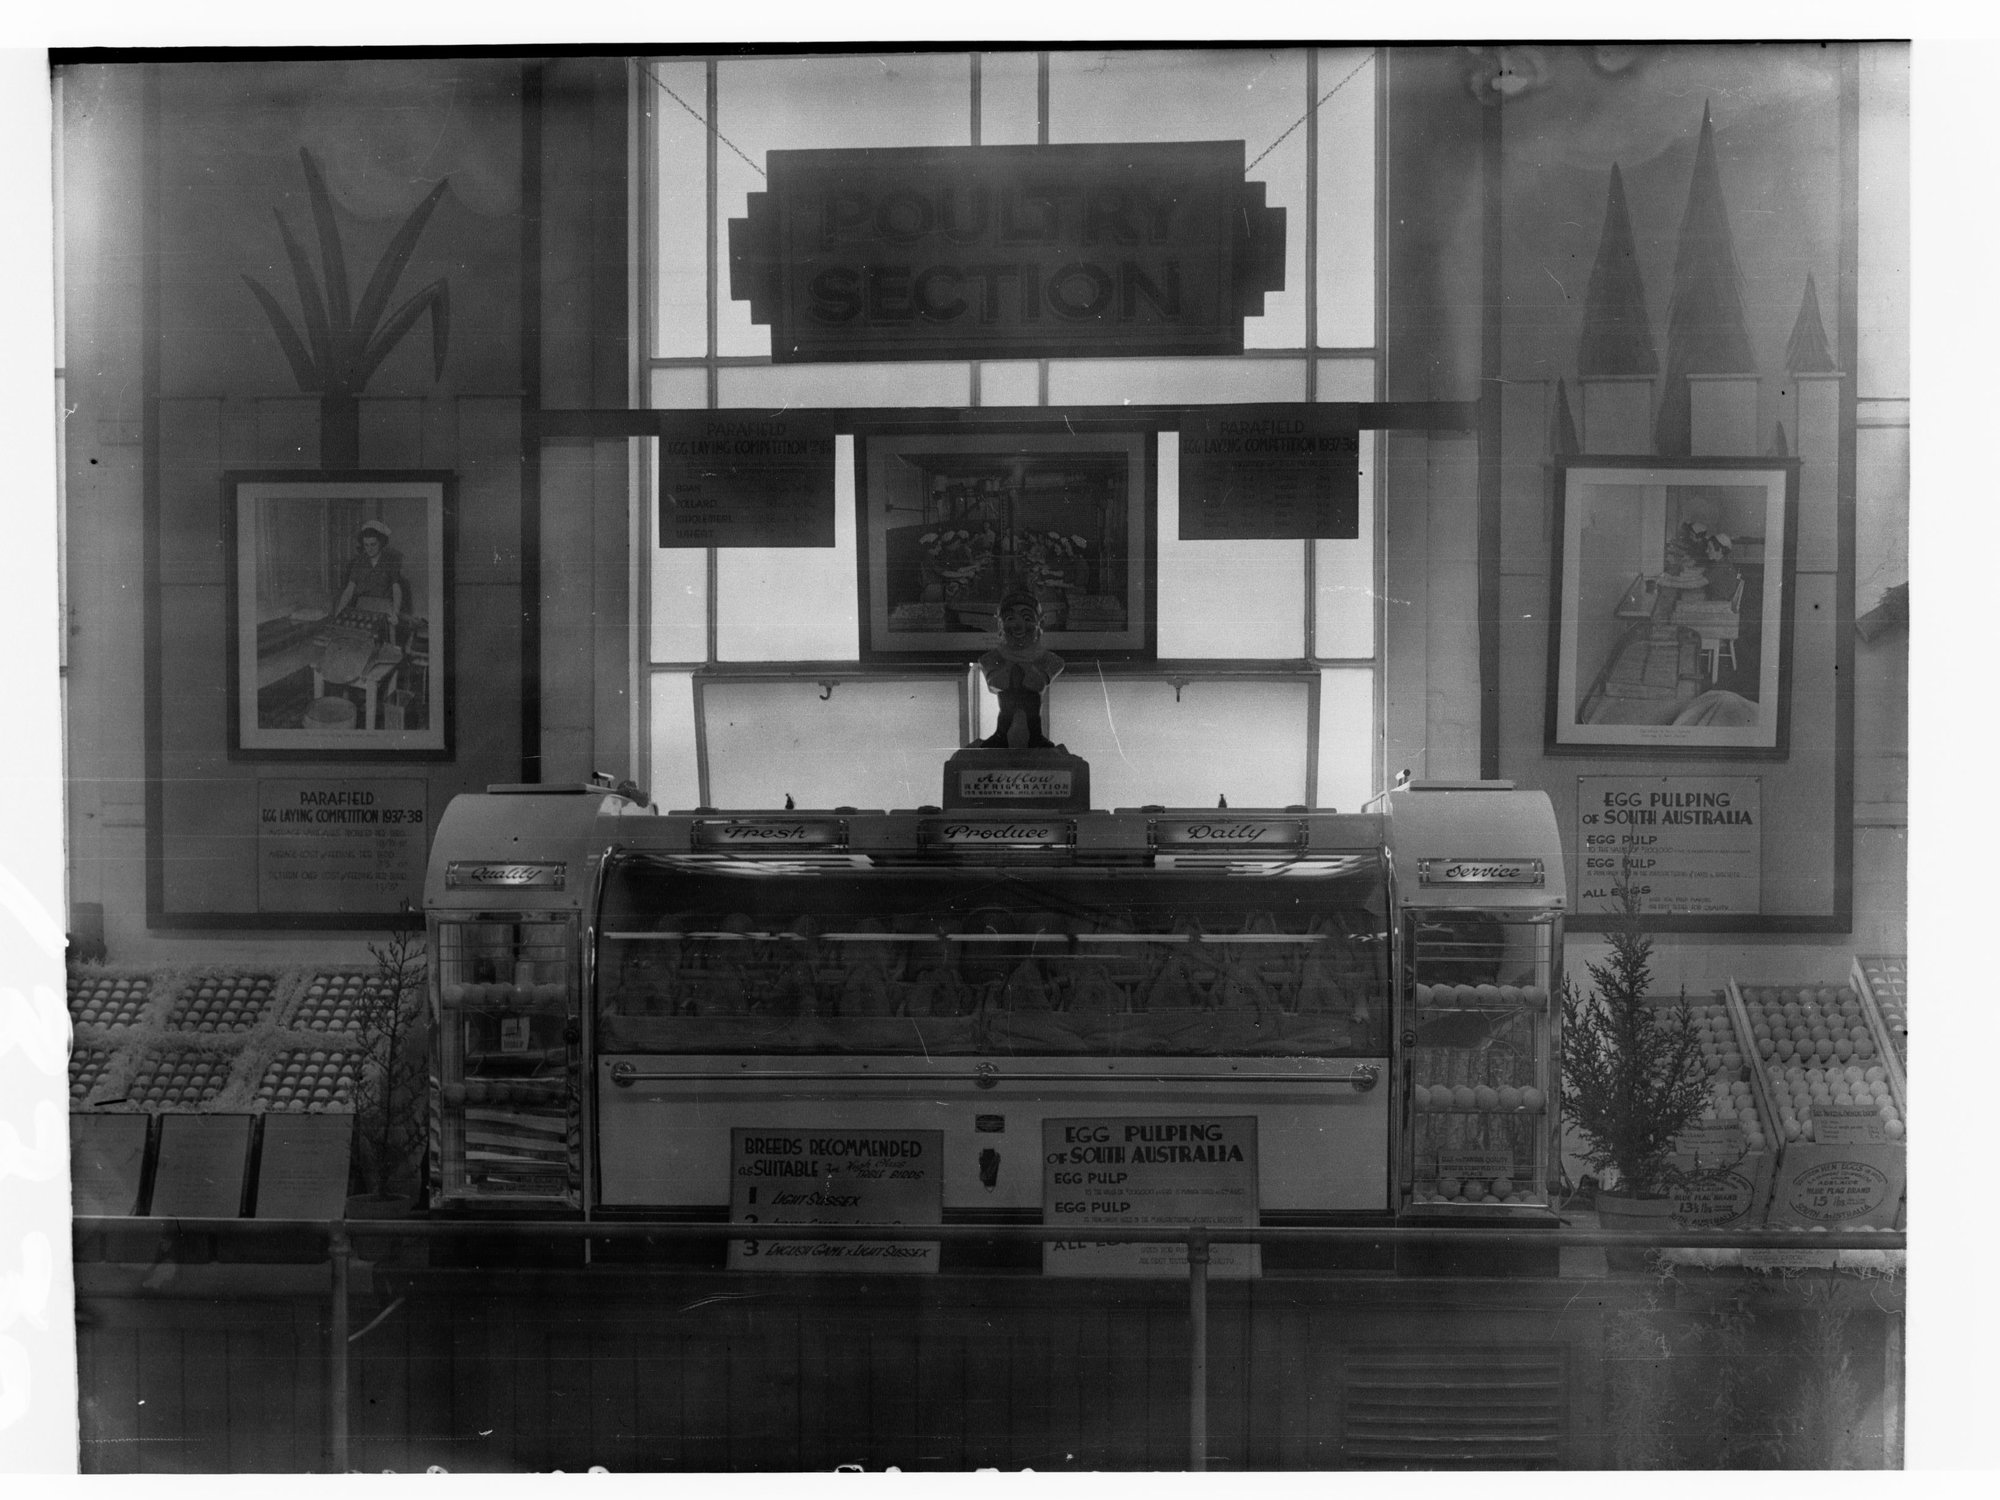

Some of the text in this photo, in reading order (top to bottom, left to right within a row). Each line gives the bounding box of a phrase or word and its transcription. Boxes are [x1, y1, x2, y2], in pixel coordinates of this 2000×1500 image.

[821, 184, 1184, 244] POULTRY
[808, 262, 1182, 324] SECTION
[1220, 420, 1304, 434] PARAFIELD
[691, 440, 730, 455] LAYING
[1203, 439, 1241, 453] LAYING
[1244, 437, 1316, 452] COMPETITION
[977, 773, 1053, 787] Airflow
[300, 791, 375, 806] PARAFIELD
[1603, 791, 1731, 808] EGG PULPING
[262, 809, 423, 823] EGG LAYING COMPETITION 1937-38
[1582, 809, 1753, 826] OF SOUTH AUSTRALIA
[724, 825, 808, 839] Fresh
[943, 824, 1049, 839] Produce
[1187, 824, 1267, 841] Daily
[1586, 834, 1658, 845] EGG PULP
[1586, 858, 1657, 868] EGG PULP
[471, 867, 542, 883] Quality
[1445, 864, 1521, 878] Service
[1582, 888, 1608, 898] ALL
[1065, 1124, 1223, 1143] EGG PULPING
[744, 1137, 922, 1158] BREEDS RECOMMENDED
[1047, 1145, 1244, 1165] OF SOUTH AUSTRALIA
[753, 1160, 819, 1177] SUITABLE
[1054, 1172, 1128, 1184] EGG PULP
[748, 1186, 757, 1204] 1
[771, 1190, 862, 1207] LIGHT SUSSEX
[1826, 1187, 1846, 1195] FLAG
[1054, 1202, 1131, 1213] EGG PULP
[1813, 1195, 1828, 1207] 15
[743, 1238, 760, 1257] 3
[765, 1242, 813, 1257] ENGLISH
[811, 1242, 847, 1257] GAME
[855, 1243, 885, 1257] LIGHT
[884, 1244, 932, 1258] SUSSEX
